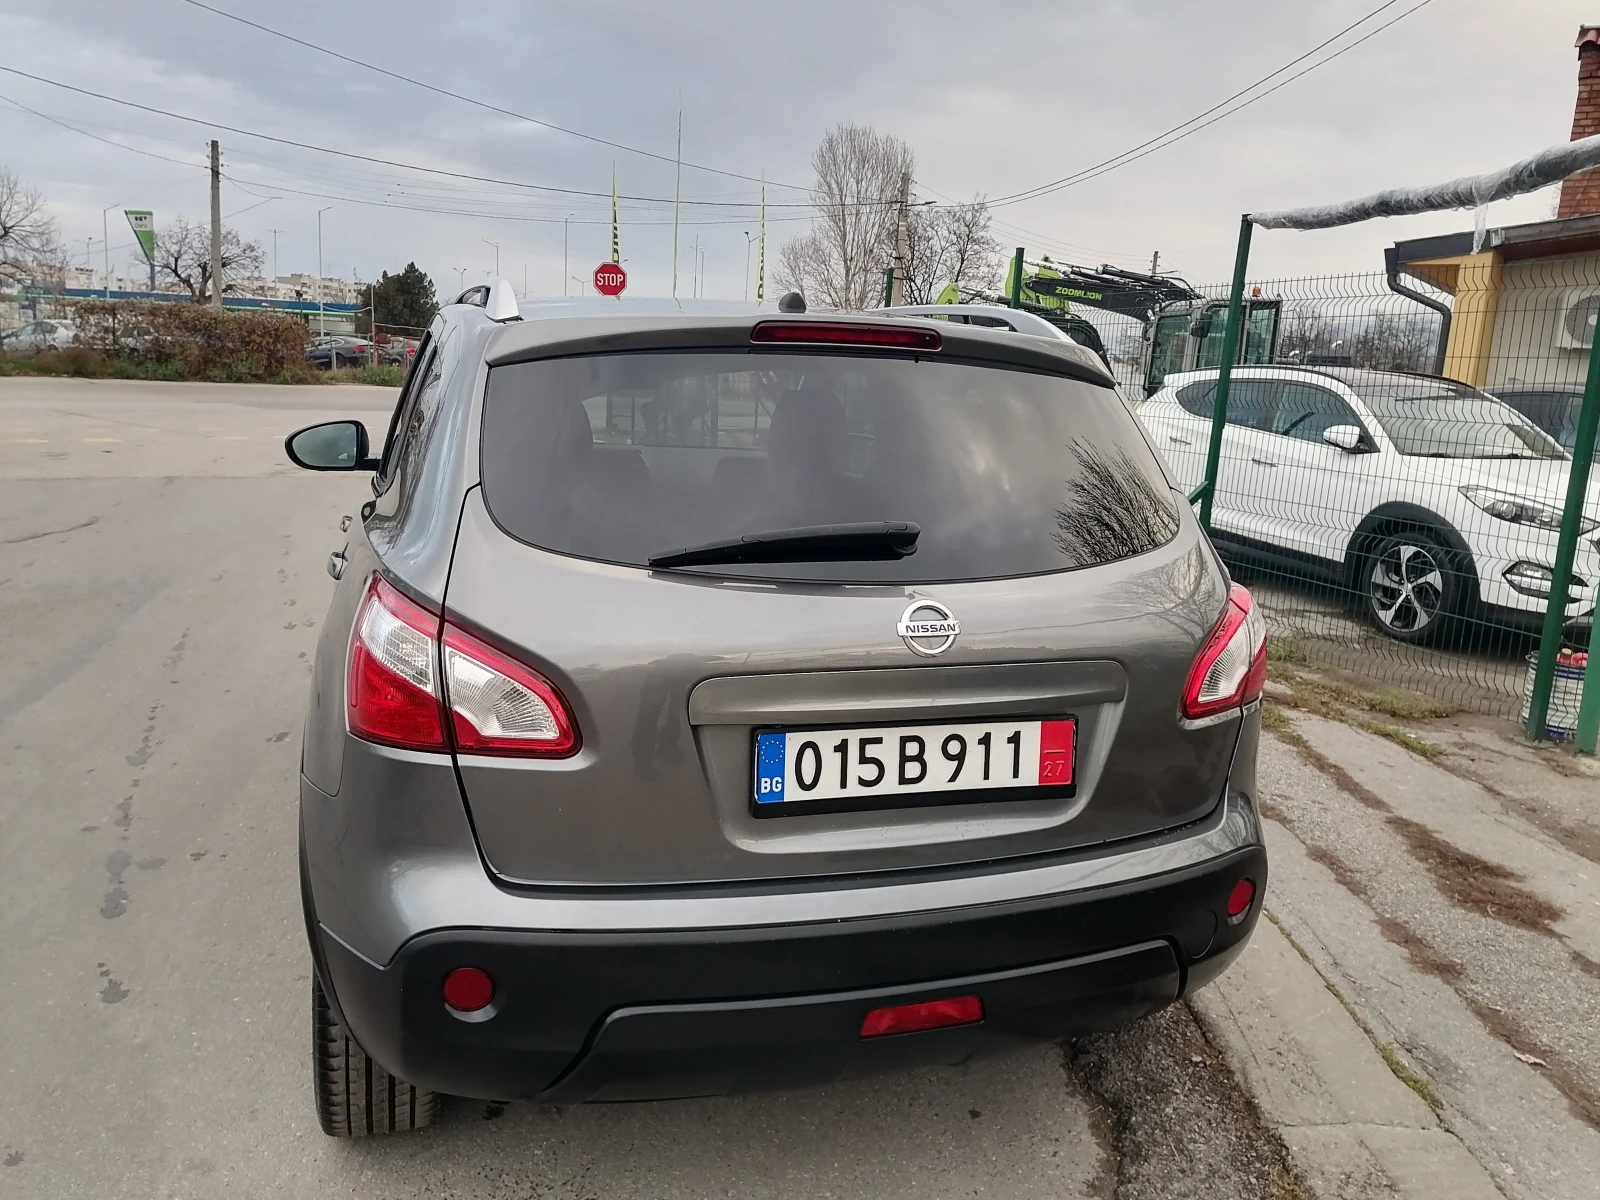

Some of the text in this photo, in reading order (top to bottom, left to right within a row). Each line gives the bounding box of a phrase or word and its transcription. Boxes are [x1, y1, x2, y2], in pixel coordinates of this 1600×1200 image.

[597, 273, 624, 286] STOP
[905, 623, 956, 633] NISSAN
[760, 776, 783, 794] BG
[1043, 760, 1065, 777] 27
